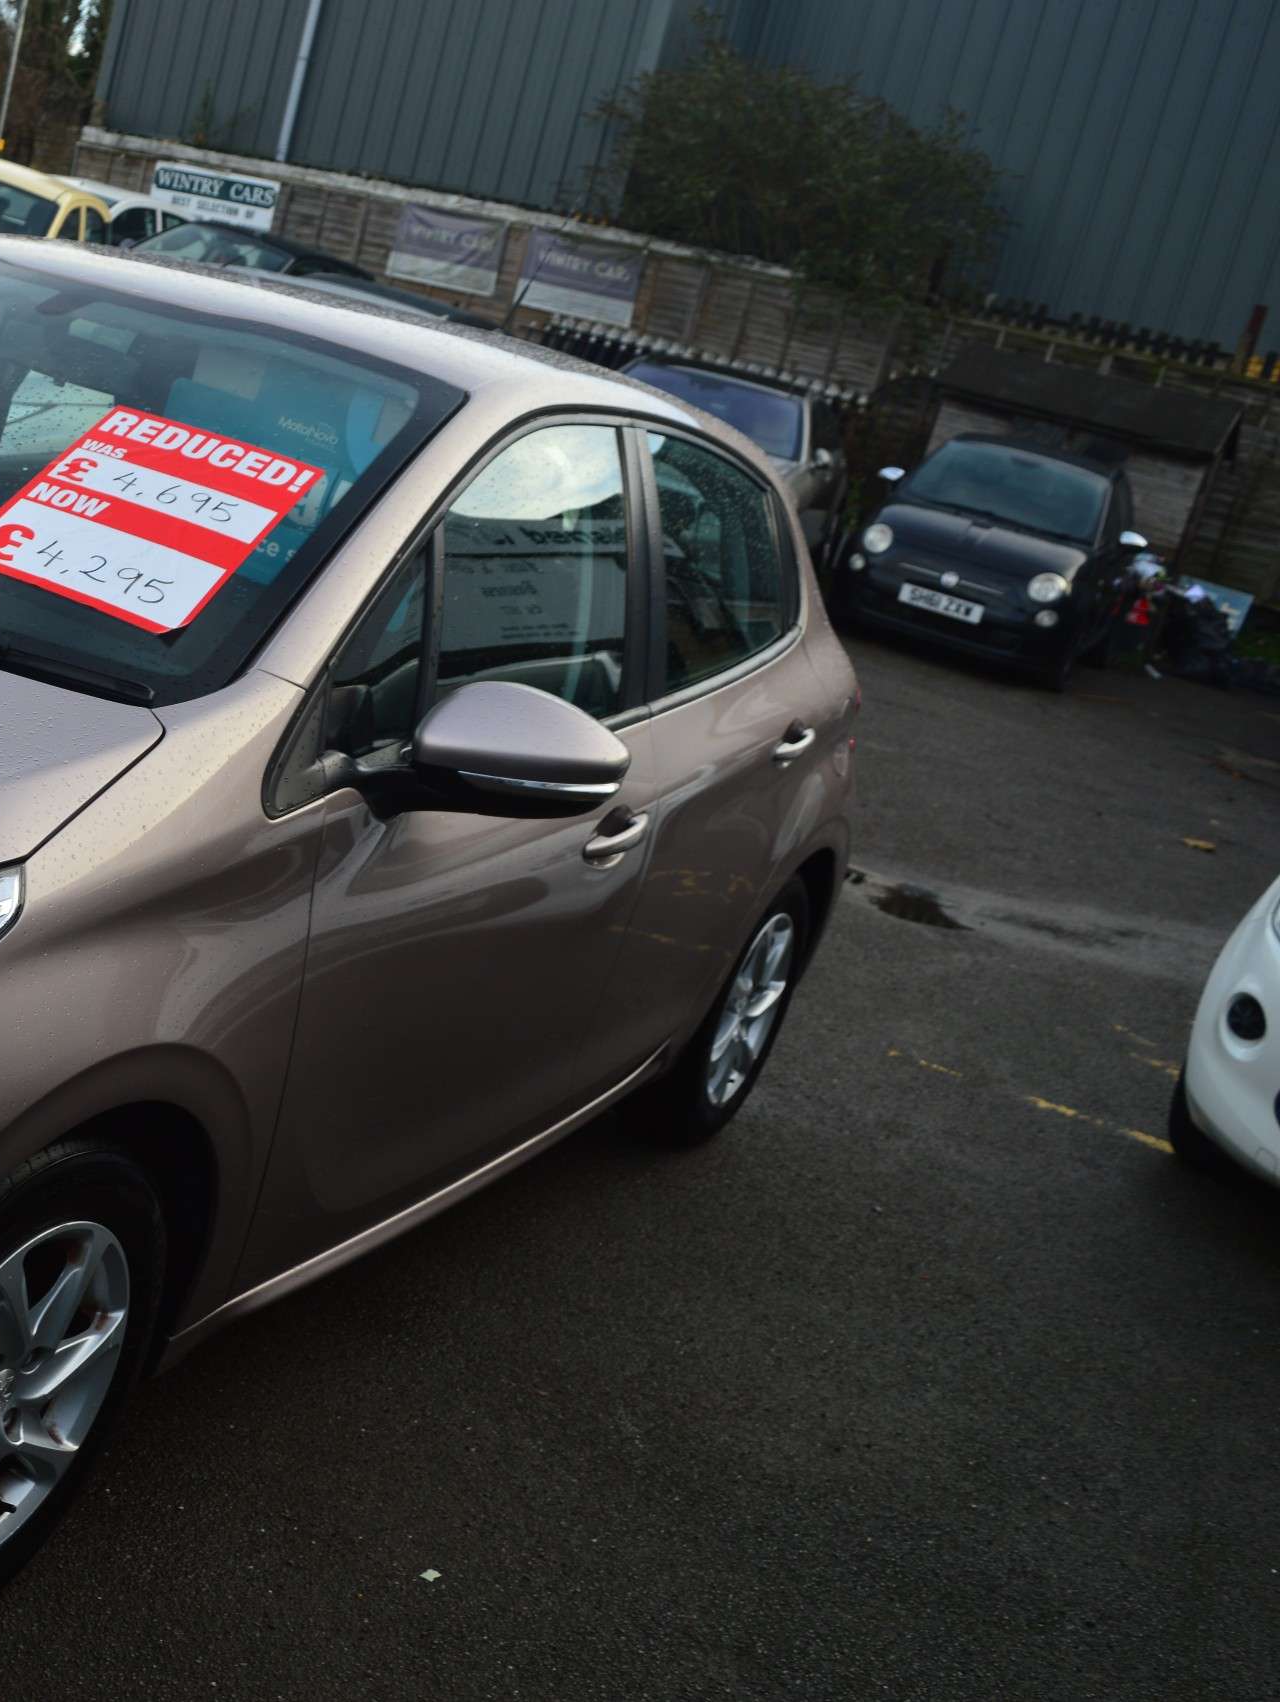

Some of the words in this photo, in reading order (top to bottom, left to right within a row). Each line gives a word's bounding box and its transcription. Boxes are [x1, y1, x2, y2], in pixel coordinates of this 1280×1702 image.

[158, 169, 223, 197] WINTRY
[229, 183, 274, 205] CARS
[278, 416, 339, 445] MotoNovo
[81, 438, 127, 460] WAS
[99, 410, 315, 494] REDUCED!
[56, 457, 99, 482] £
[26, 480, 111, 519] NOW
[36, 538, 175, 604] 4,295
